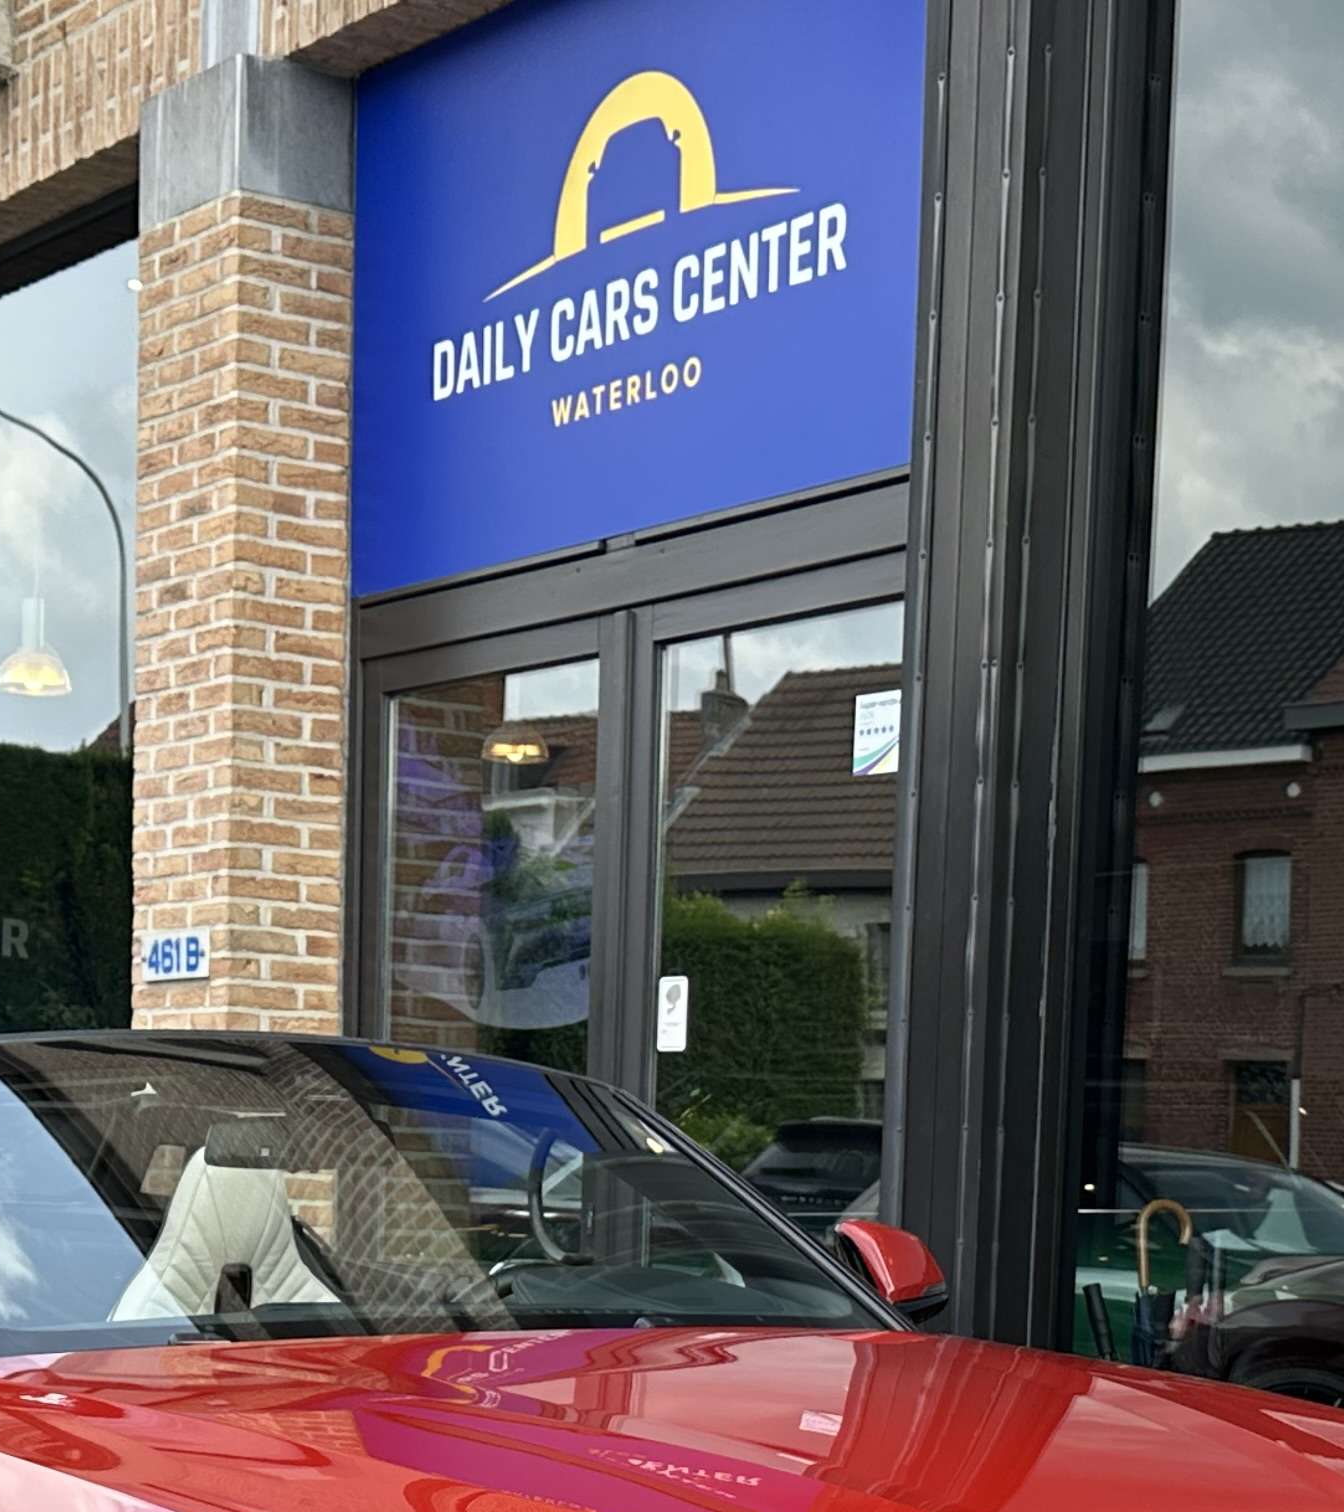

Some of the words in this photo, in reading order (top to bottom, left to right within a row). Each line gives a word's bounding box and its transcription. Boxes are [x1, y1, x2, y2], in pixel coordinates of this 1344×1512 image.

[432, 308, 540, 402] DAILY
[550, 267, 658, 363] CARS
[673, 202, 848, 323] CENTER
[551, 355, 703, 428] WATERLOO
